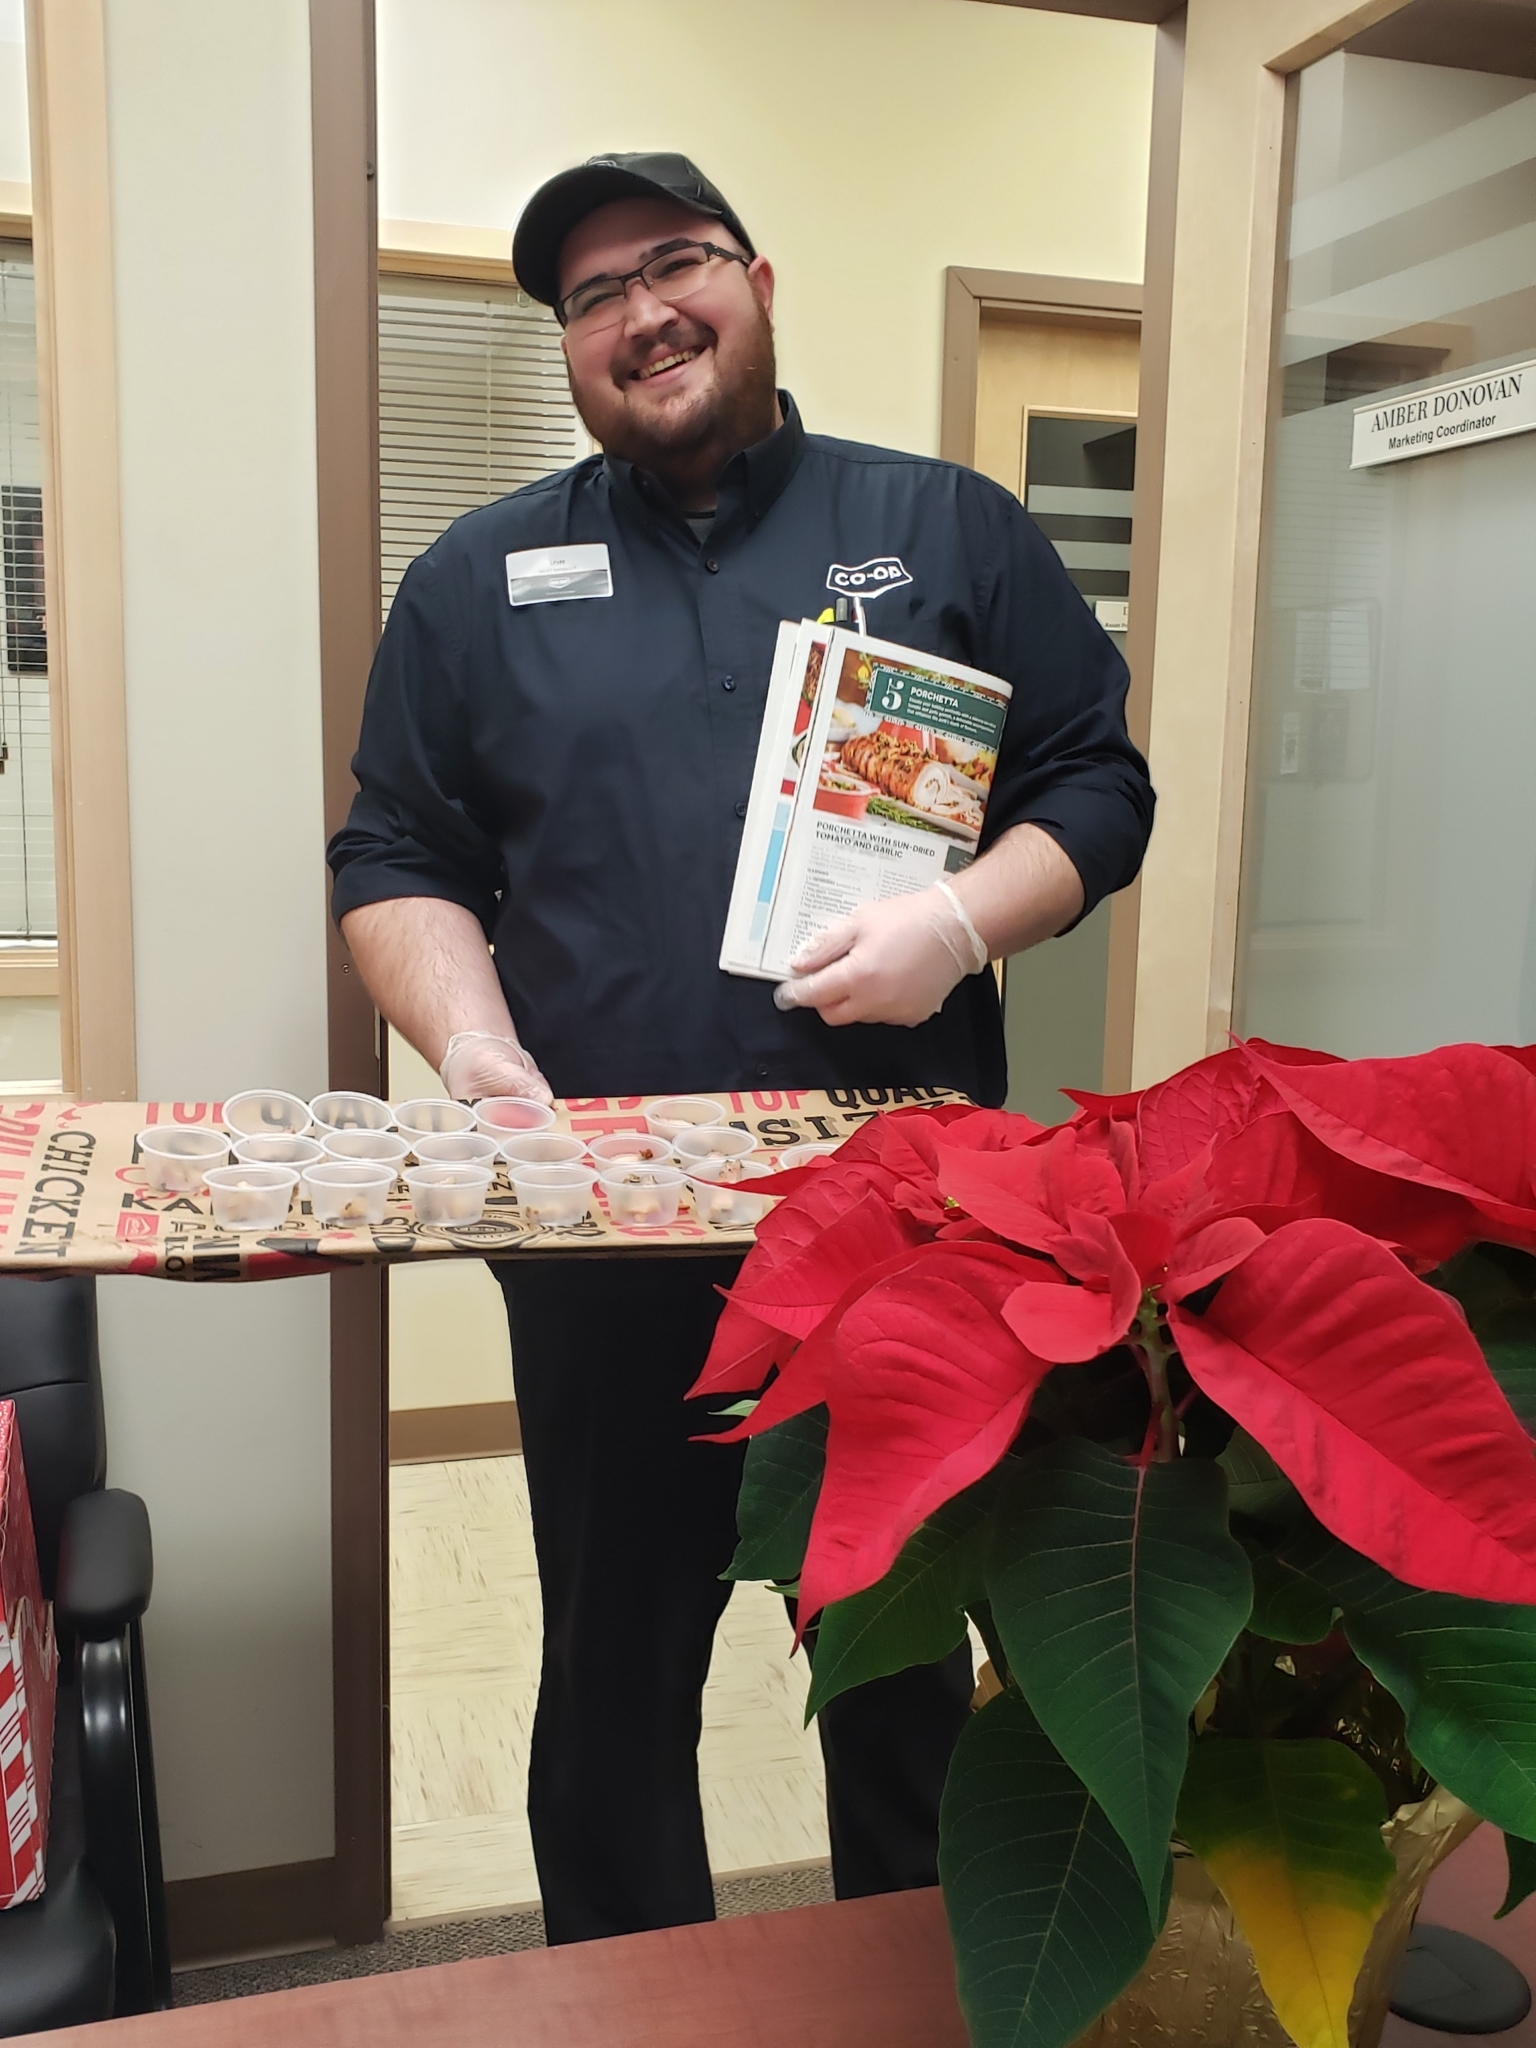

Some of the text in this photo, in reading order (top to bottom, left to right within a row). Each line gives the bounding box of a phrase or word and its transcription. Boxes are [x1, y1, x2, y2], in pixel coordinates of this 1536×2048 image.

[1371, 373, 1523, 433] AMBER DONOVAN
[1388, 414, 1497, 450] Marketing Coordinator
[834, 566, 902, 586] CO-OP
[881, 677, 904, 711] 5
[910, 686, 959, 708] PORCHETTA
[815, 831, 903, 859] TOMATO AND GARLIC
[816, 820, 936, 857] PORCHETTA WITH SUN-DRIED
[14, 1130, 97, 1258] CHICKEN
